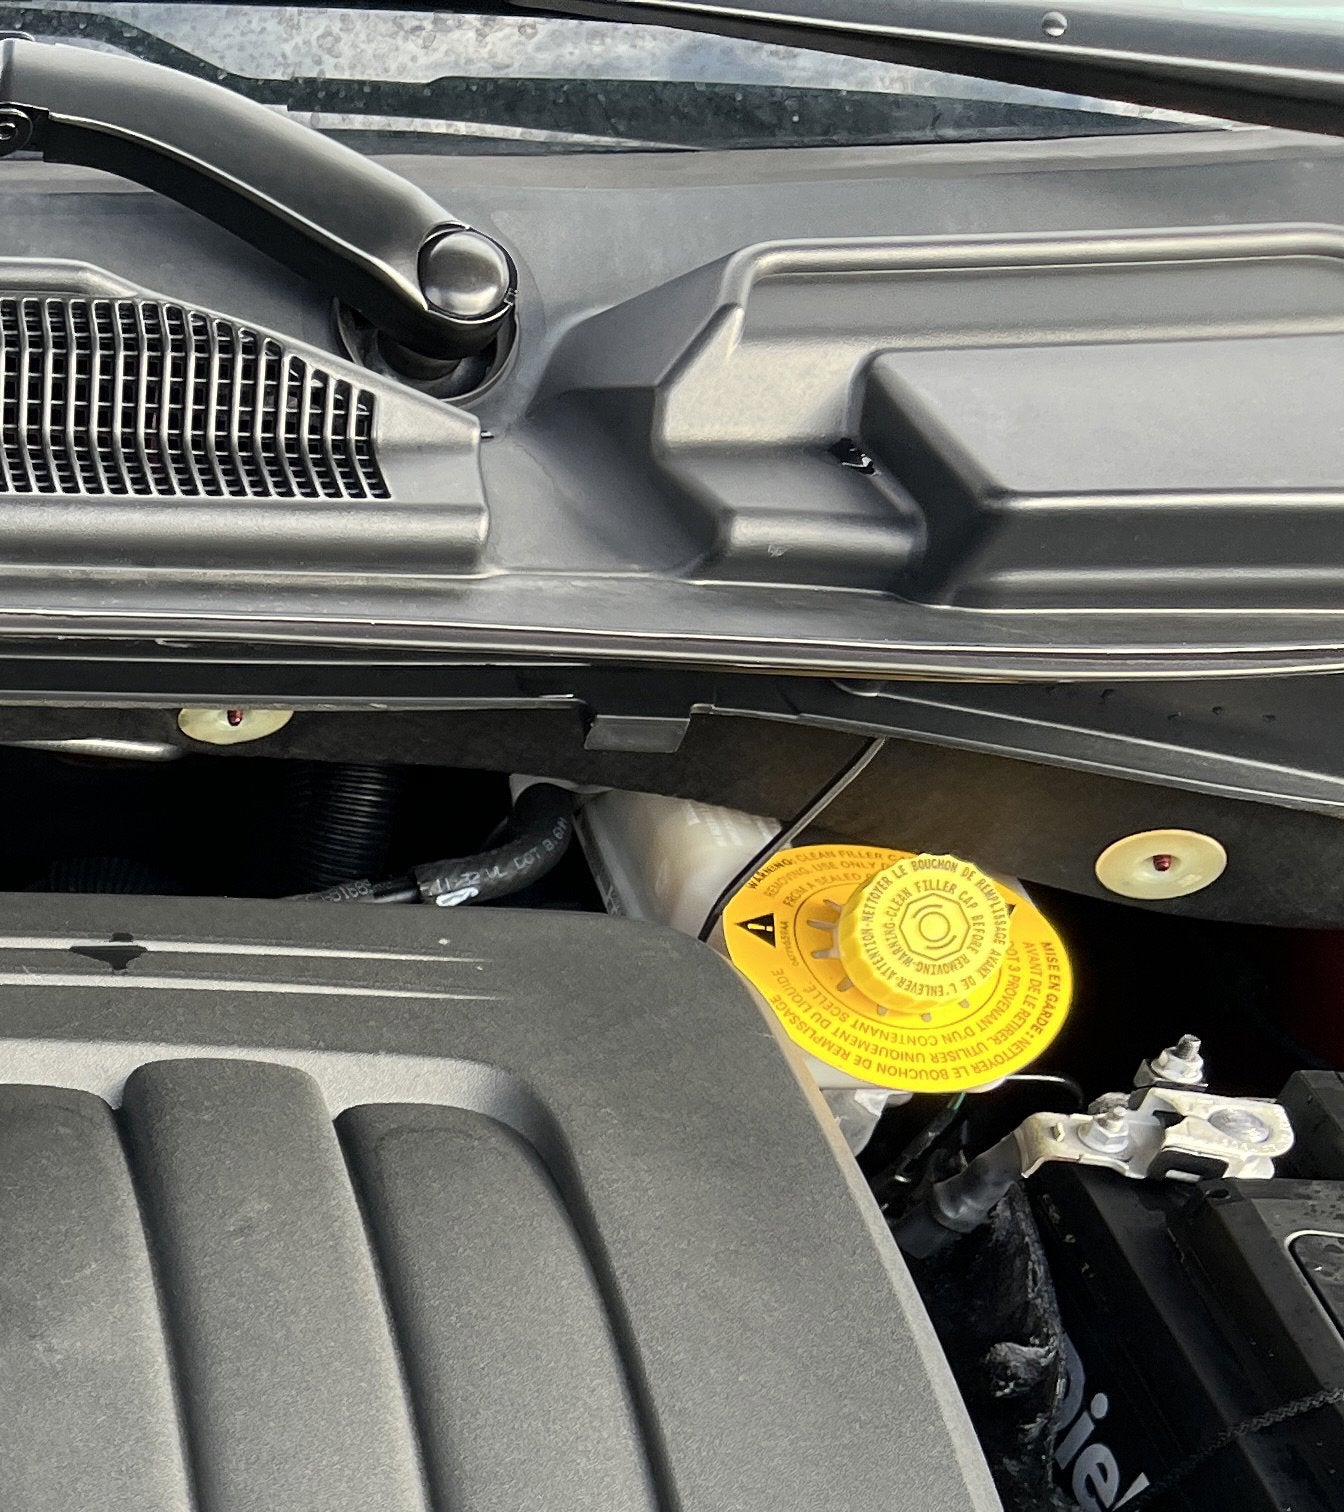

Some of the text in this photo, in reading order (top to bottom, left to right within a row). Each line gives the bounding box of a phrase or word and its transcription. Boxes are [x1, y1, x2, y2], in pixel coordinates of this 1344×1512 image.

[796, 851, 836, 862] CLEAN
[839, 850, 883, 860] FILLER
[812, 862, 837, 871] USE
[840, 860, 875, 870] ONLY
[892, 865, 908, 878] LE
[911, 859, 958, 872] BOUCHON
[962, 867, 977, 881] DE
[783, 888, 805, 907] FROM
[817, 872, 862, 885] SEALED
[914, 879, 958, 894] FILLER
[958, 890, 978, 909] CAP
[975, 878, 1008, 946] REMPLISSAGE
[966, 914, 985, 954] BEFORE
[1006, 941, 1020, 963] OT
[1023, 942, 1042, 980] AVANT
[1041, 941, 1060, 973] MISE
[980, 949, 1002, 979] AVANT
[1008, 965, 1020, 973] 3
[770, 968, 811, 1013] LIQUIDE
[962, 975, 976, 990] DE
[1029, 981, 1042, 994] DE
[1048, 975, 1061, 992] EN
[977, 975, 1020, 1030] PROVENANT
[1023, 995, 1038, 1009] LE
[770, 994, 851, 1061] REMPLISSAGE
[810, 1011, 832, 1029] DU
[850, 1019, 938, 1046] CONTENANT
[831, 1026, 925, 1063] UNIQUEMENT
[931, 1042, 989, 1063] UTILISER
[853, 1056, 872, 1070] DE
[972, 1037, 1032, 1074] NETTOYER
[876, 1063, 949, 1080] BOUCHON
[953, 1065, 970, 1079] LE
